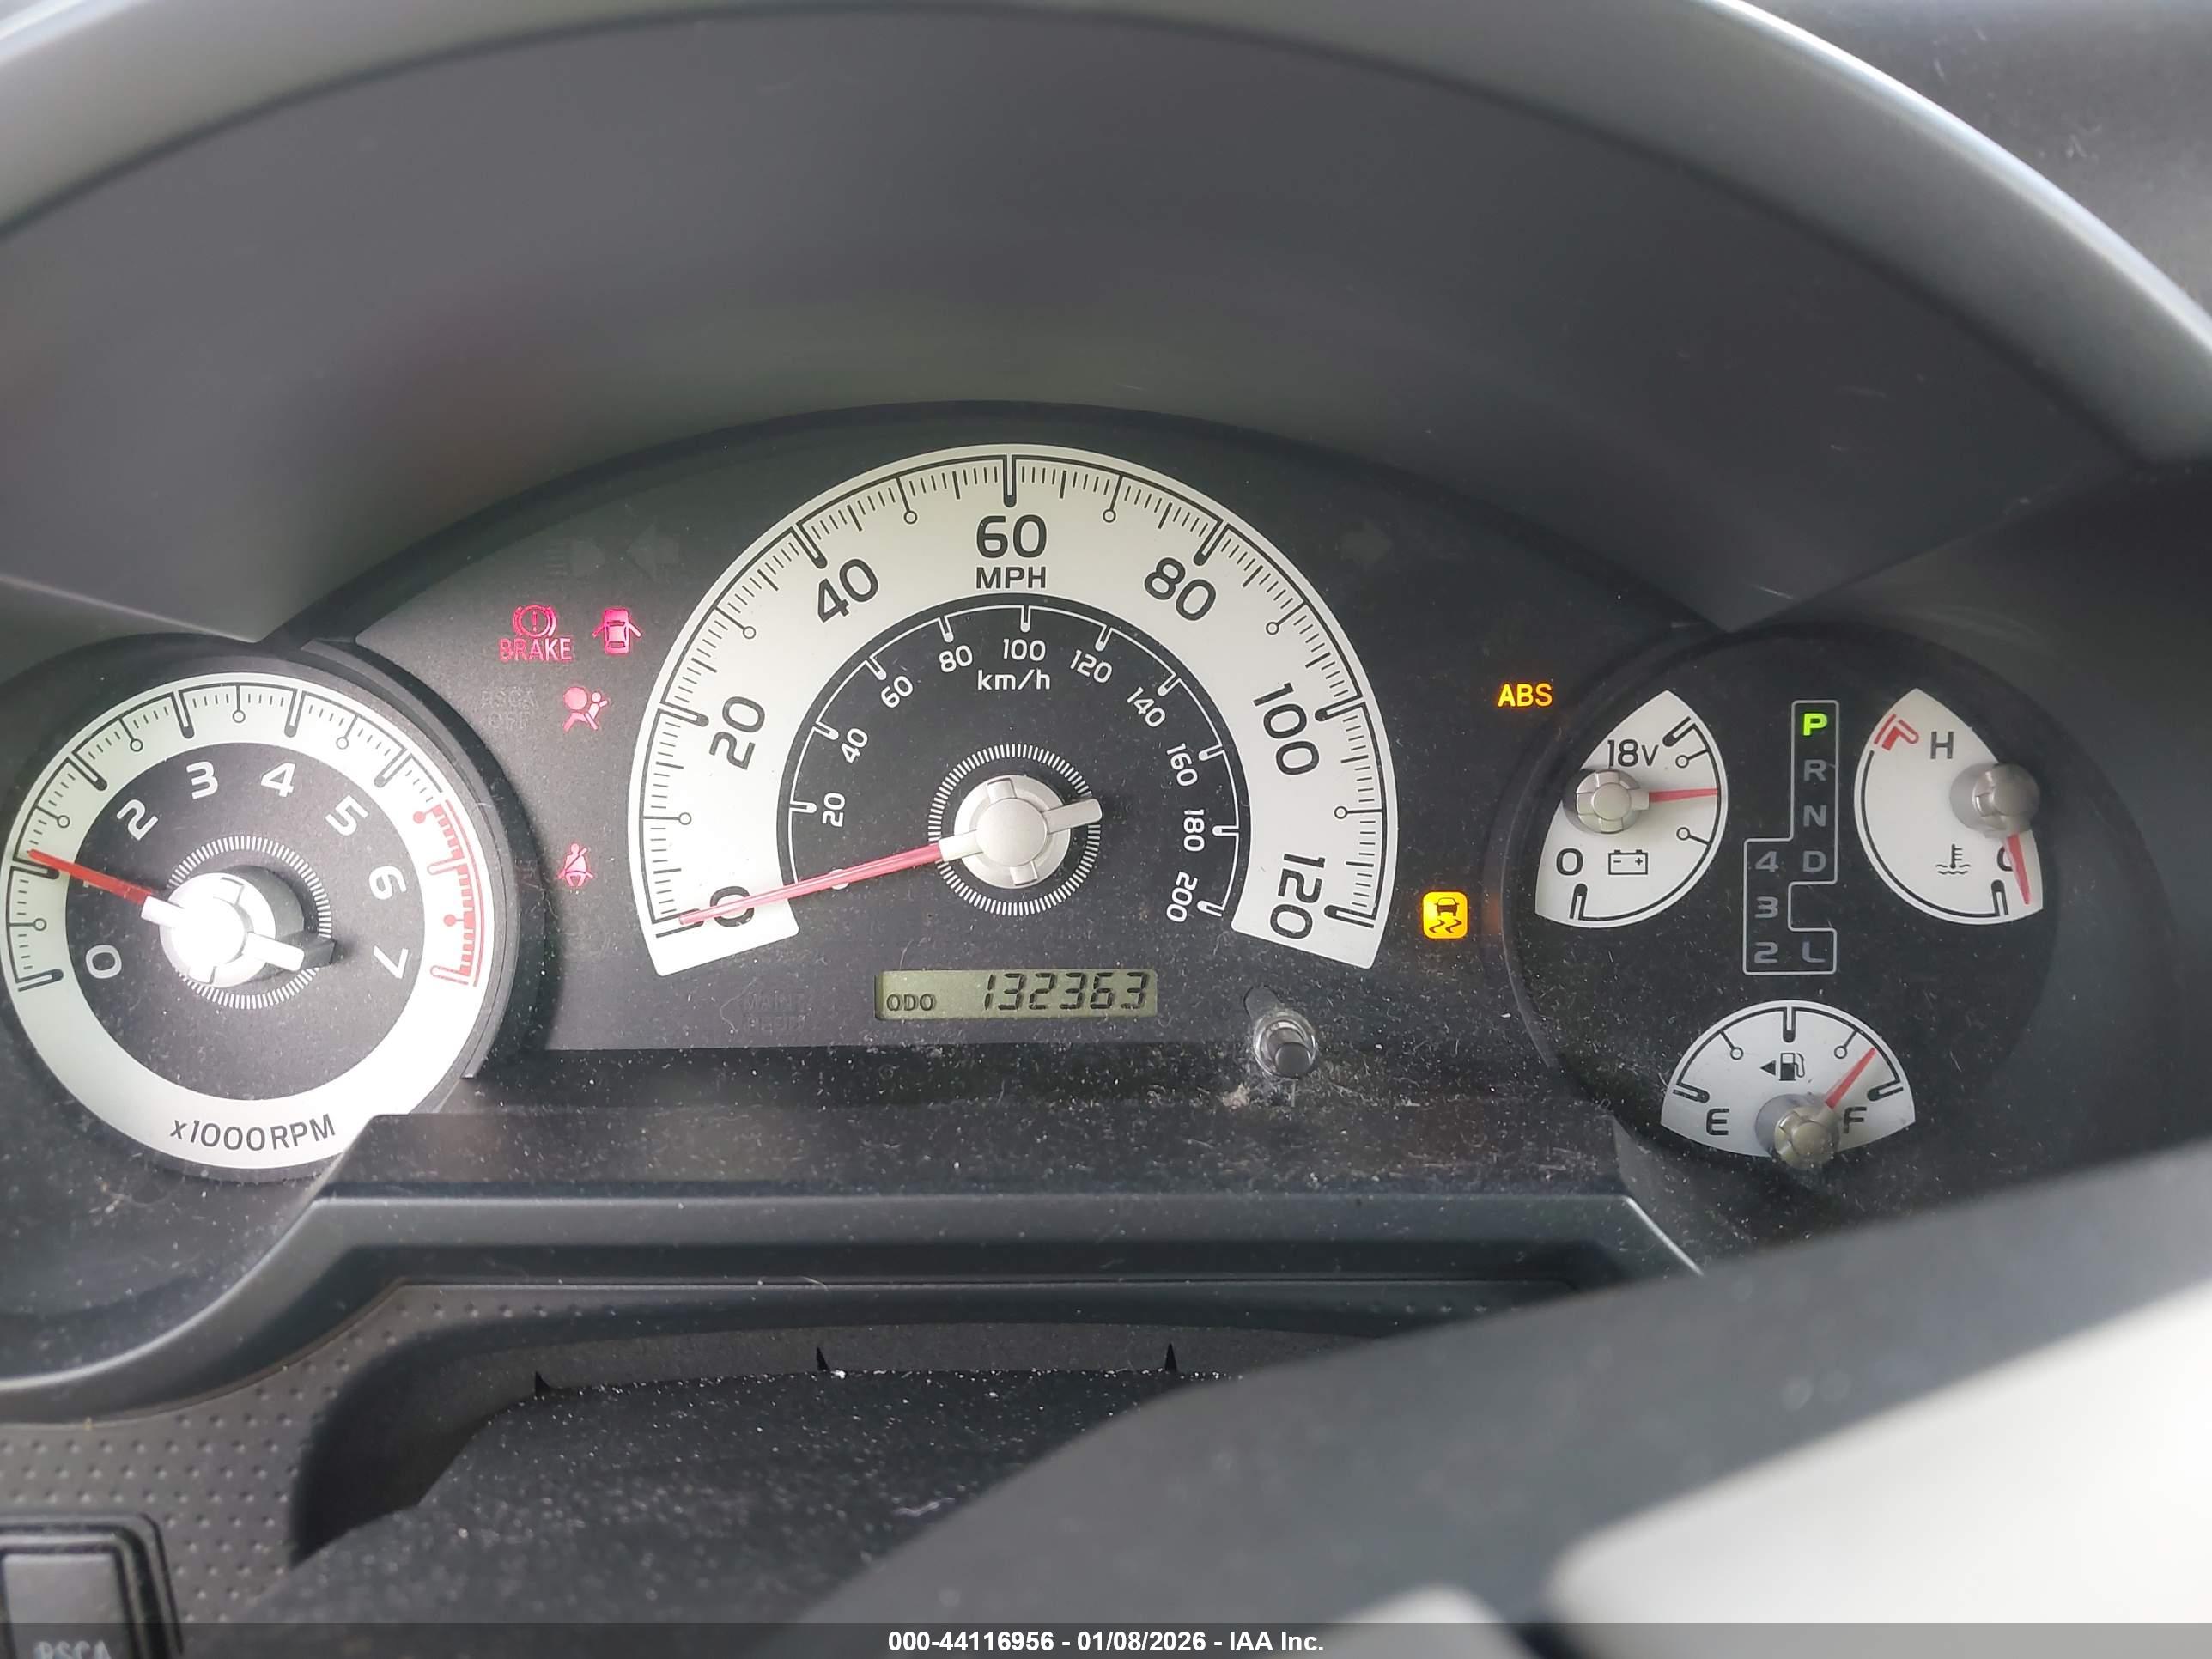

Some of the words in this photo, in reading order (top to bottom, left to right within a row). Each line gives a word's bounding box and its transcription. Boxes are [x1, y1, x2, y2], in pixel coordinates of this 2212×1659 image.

[977, 514, 1047, 558] 60
[817, 559, 878, 623] 40
[976, 567, 1046, 588] MPH
[1145, 557, 1216, 621] 80
[499, 638, 574, 662] BRAKE
[939, 646, 974, 672] 80
[1003, 638, 1046, 661] 100
[1070, 650, 1112, 683] 120
[880, 675, 913, 708] 60
[977, 669, 1050, 690] km/h
[1498, 684, 1553, 708] ABS
[1126, 688, 1165, 727] 140
[709, 696, 765, 769] 20
[1254, 683, 1319, 775] 100
[1803, 714, 1827, 736] P
[841, 728, 868, 763] 40
[1930, 731, 1954, 759] H
[186, 761, 218, 799] 3
[261, 762, 296, 797] 4
[1166, 744, 1198, 787] 160
[1803, 760, 1827, 781] R
[117, 799, 158, 841] 2
[325, 795, 369, 836] 5
[822, 792, 845, 827] 20
[1804, 805, 1826, 827] N
[1183, 809, 1204, 851] 180
[1556, 848, 1583, 876] 0
[1755, 851, 1779, 873] 4
[1804, 851, 1826, 872] D
[369, 866, 406, 900] 6
[1166, 872, 1198, 922] 200
[1270, 854, 1325, 939] 120
[710, 885, 754, 927] 0
[1755, 896, 1778, 919] 3
[86, 945, 122, 979] 0
[374, 945, 409, 979] 7
[1754, 942, 1778, 963] 2
[1803, 942, 1825, 963] L
[887, 994, 934, 1011] ODO
[984, 971, 1149, 1010] 132363
[1706, 1108, 1729, 1136] E
[1843, 1107, 1868, 1133] F
